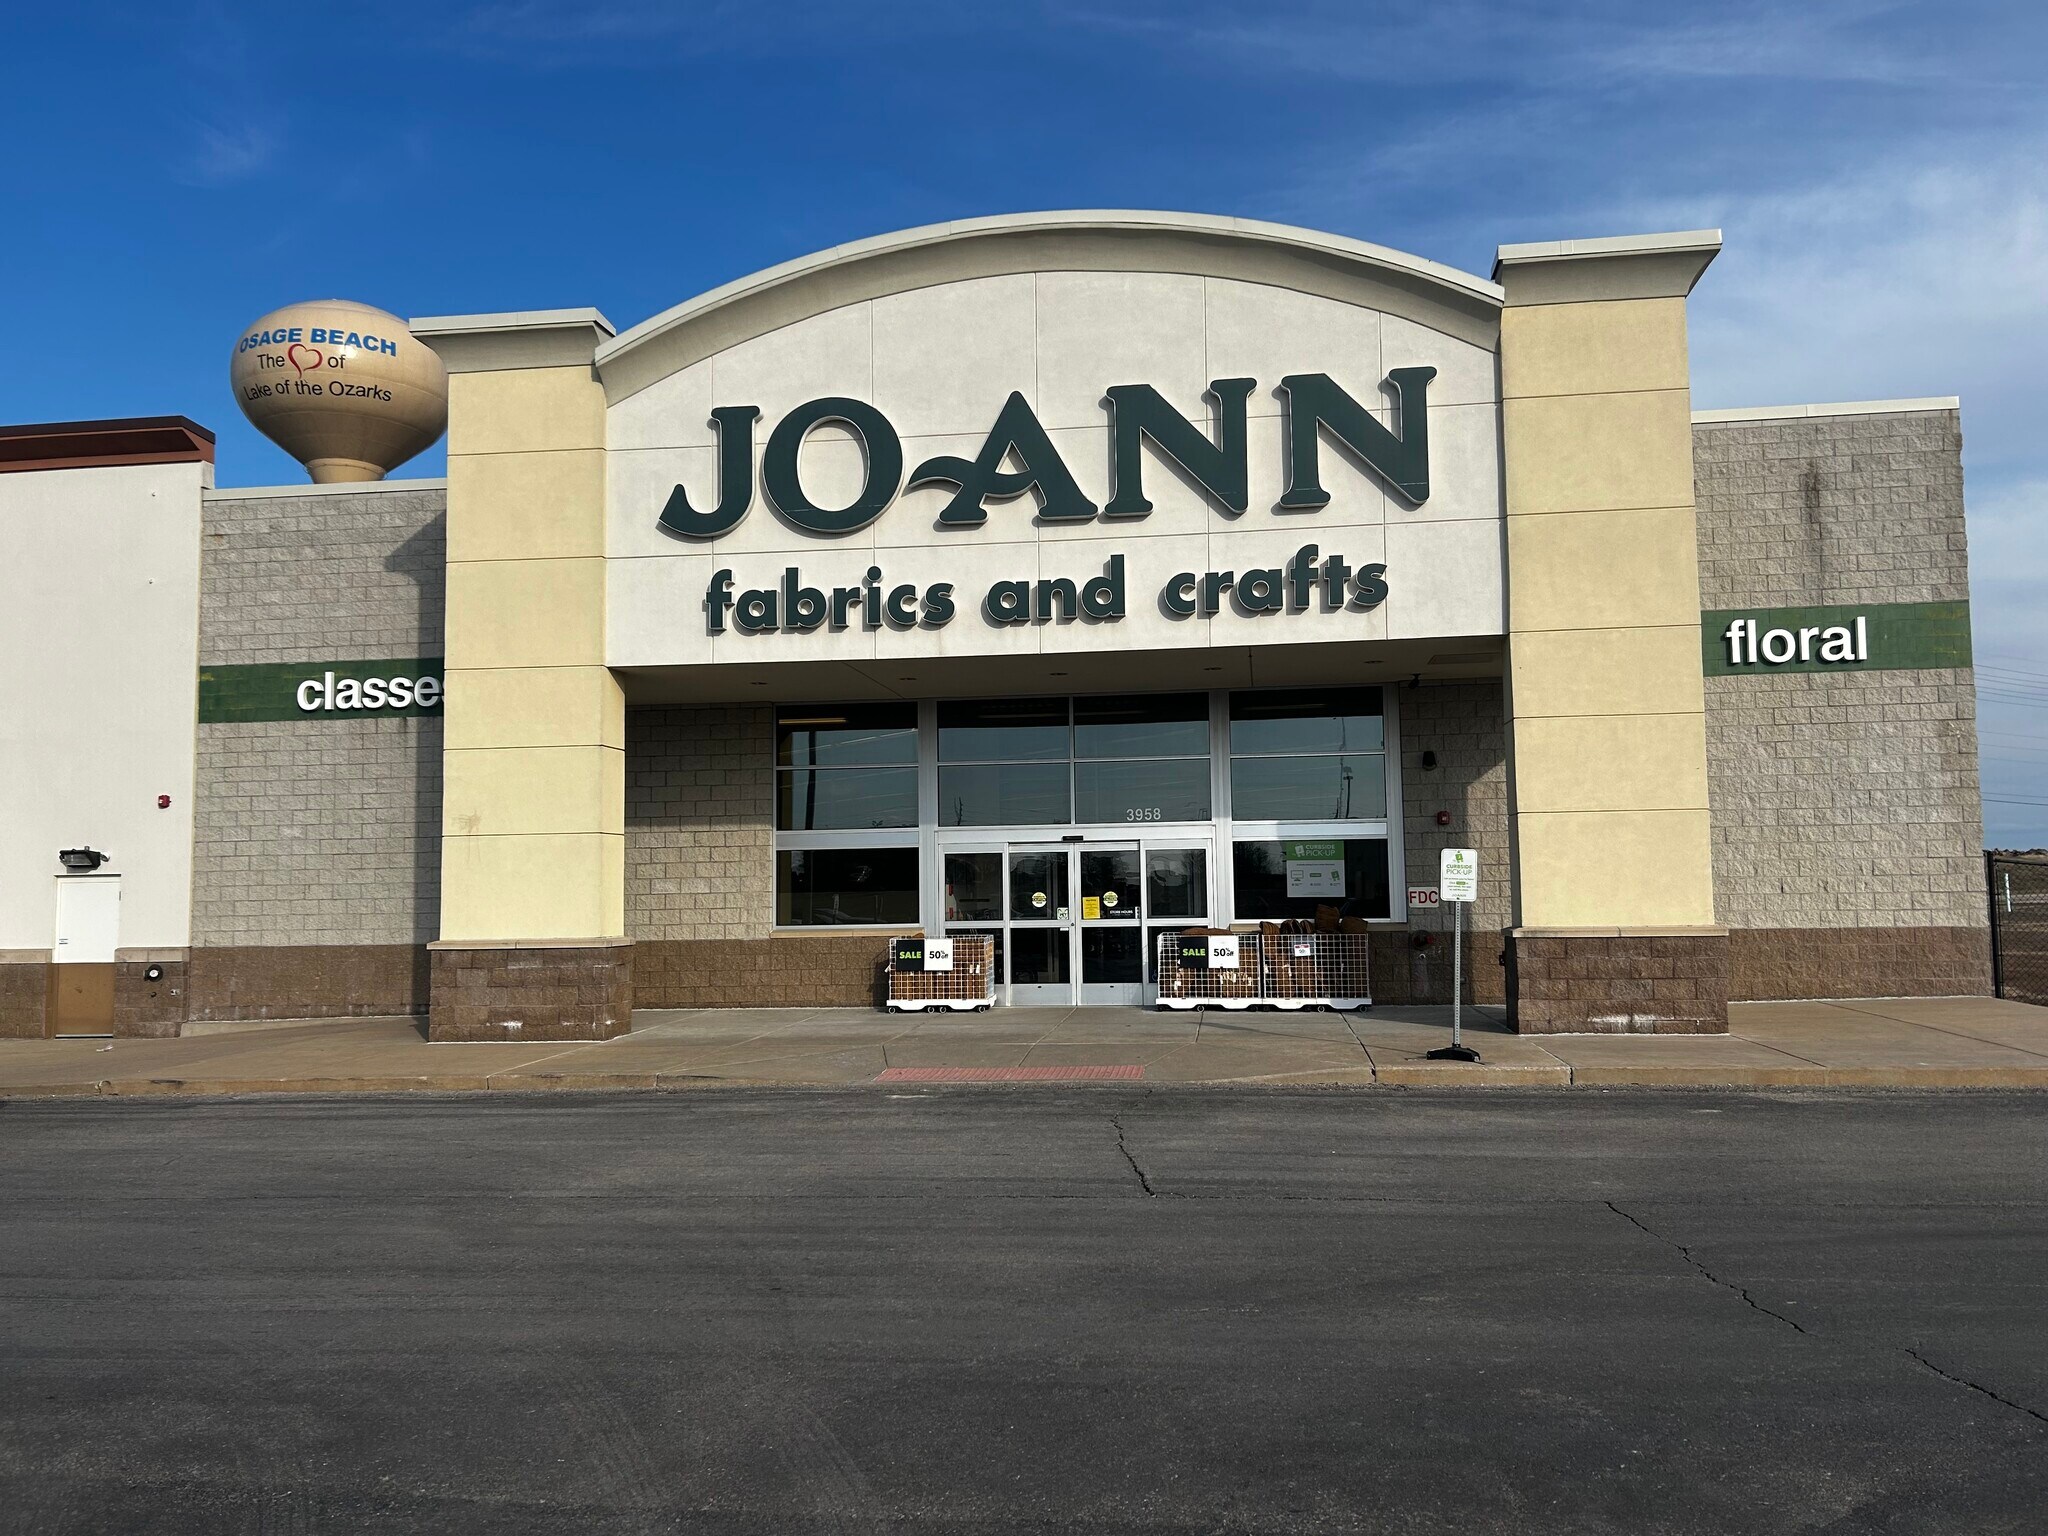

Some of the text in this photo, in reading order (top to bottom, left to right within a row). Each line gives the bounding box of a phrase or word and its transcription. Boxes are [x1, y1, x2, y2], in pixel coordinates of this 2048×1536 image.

[240, 328, 397, 357] OSAGE BEACH
[257, 353, 346, 369] The of
[243, 379, 392, 401] Lake of the Ozarks
[706, 544, 1389, 633] fabrics and crafts
[1725, 616, 1868, 664] floral
[296, 671, 445, 711] classe
[1126, 808, 1161, 821] 3958
[1305, 849, 1336, 857] PICK-UP
[1409, 889, 1439, 904] FDC
[899, 951, 922, 959] SALE
[1182, 948, 1206, 957] SALE
